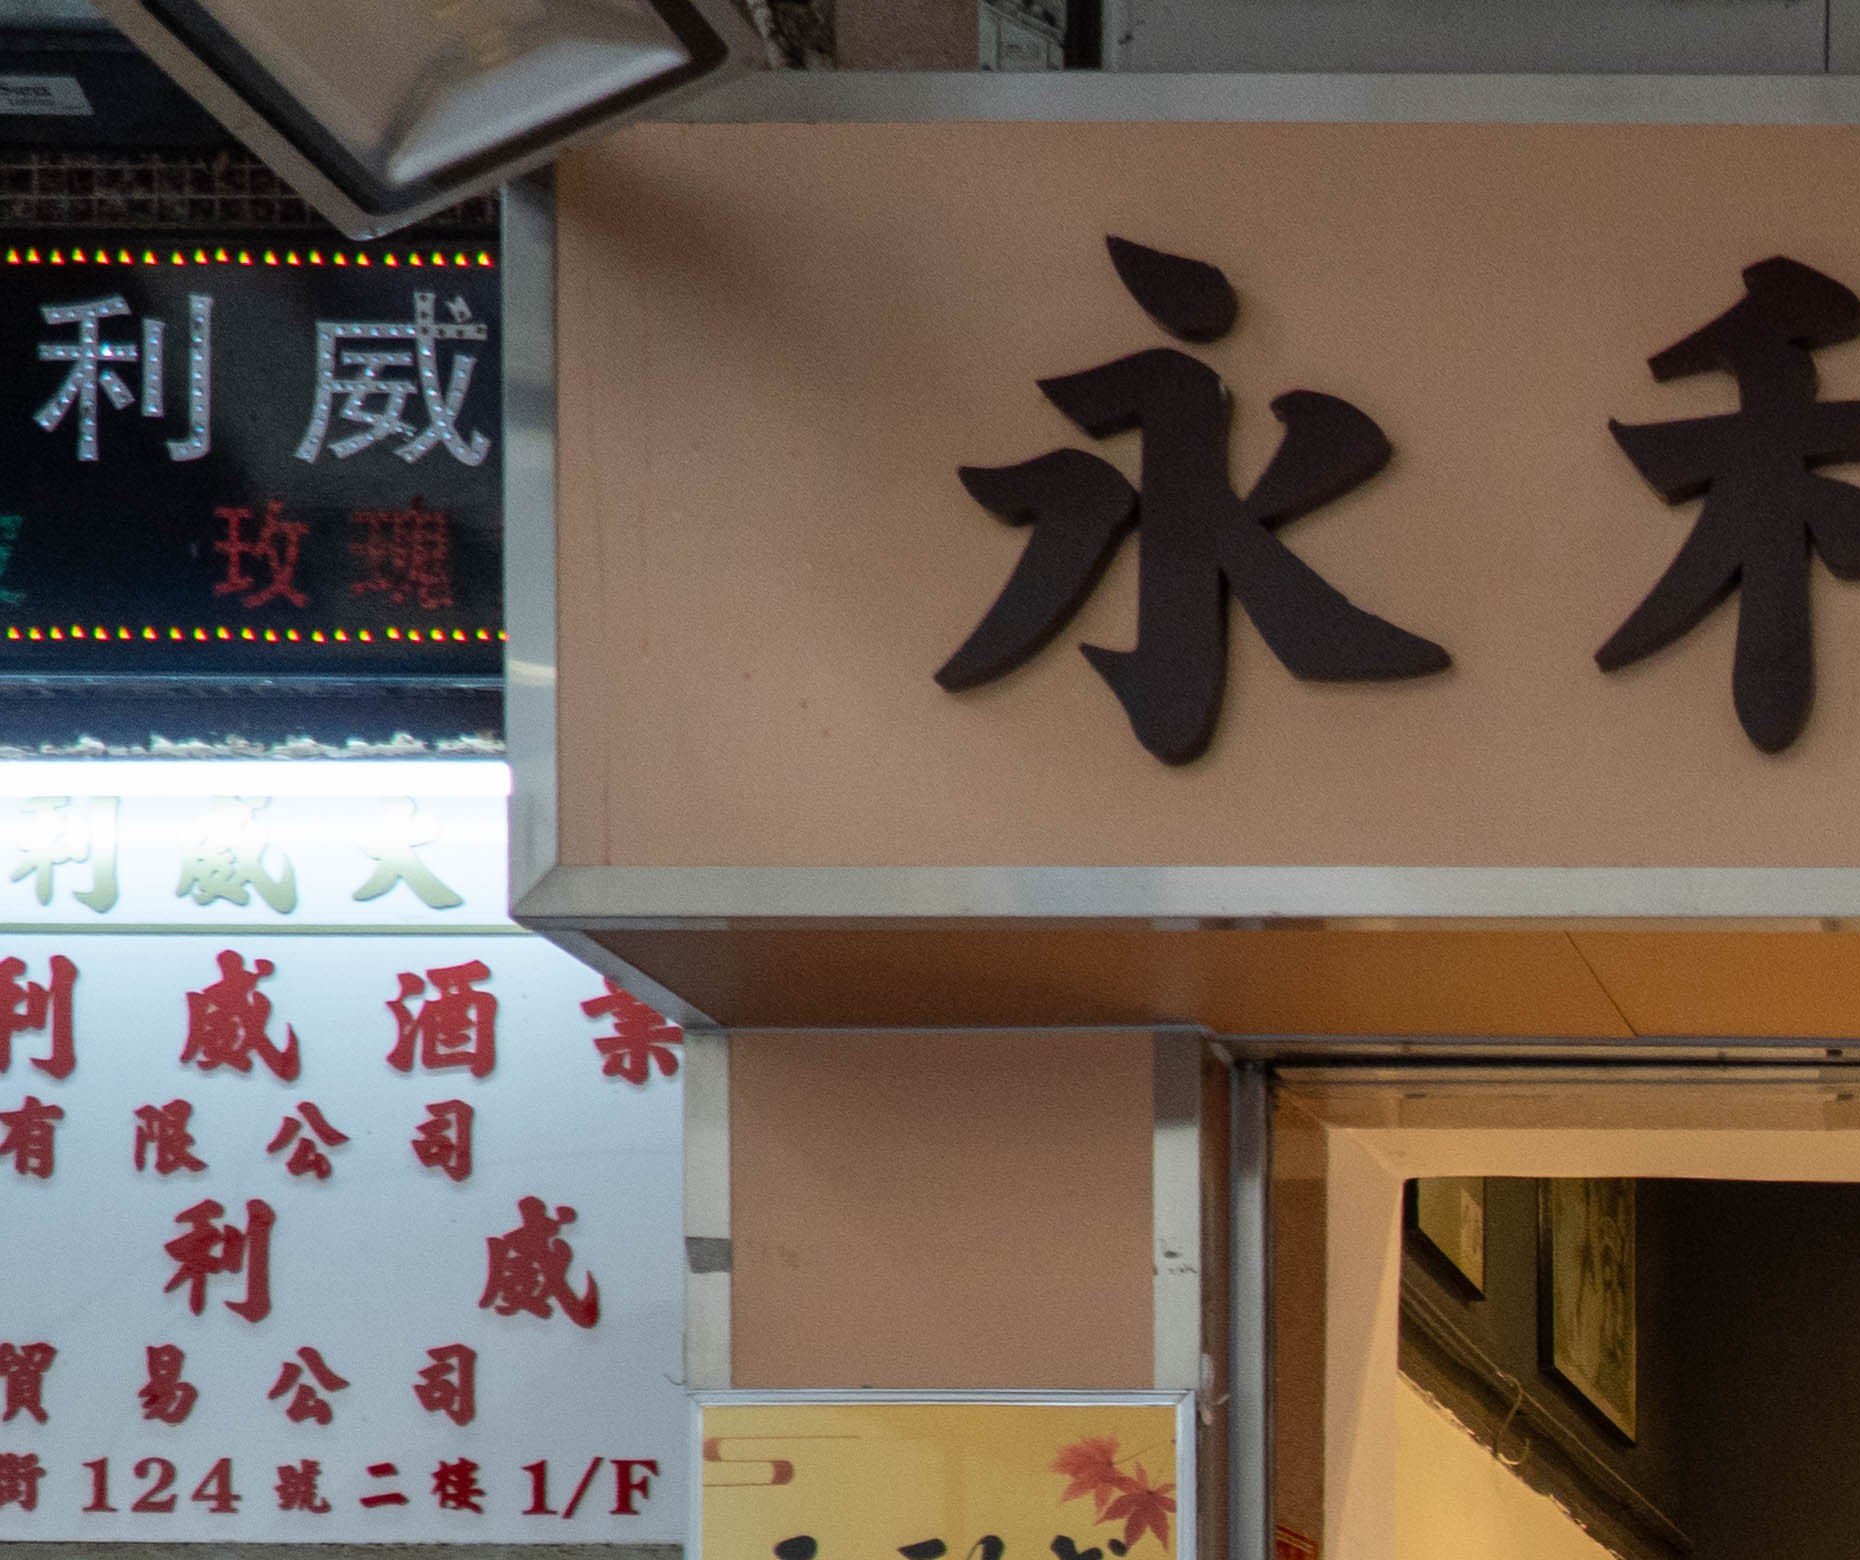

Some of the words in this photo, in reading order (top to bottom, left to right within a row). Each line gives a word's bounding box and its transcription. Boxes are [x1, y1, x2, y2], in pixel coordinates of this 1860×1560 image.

[32, 291, 491, 467] 利威
[212, 498, 454, 609] 玫瑰
[0, 1095, 475, 1182] 有限公司
[163, 1195, 600, 1329] 利威
